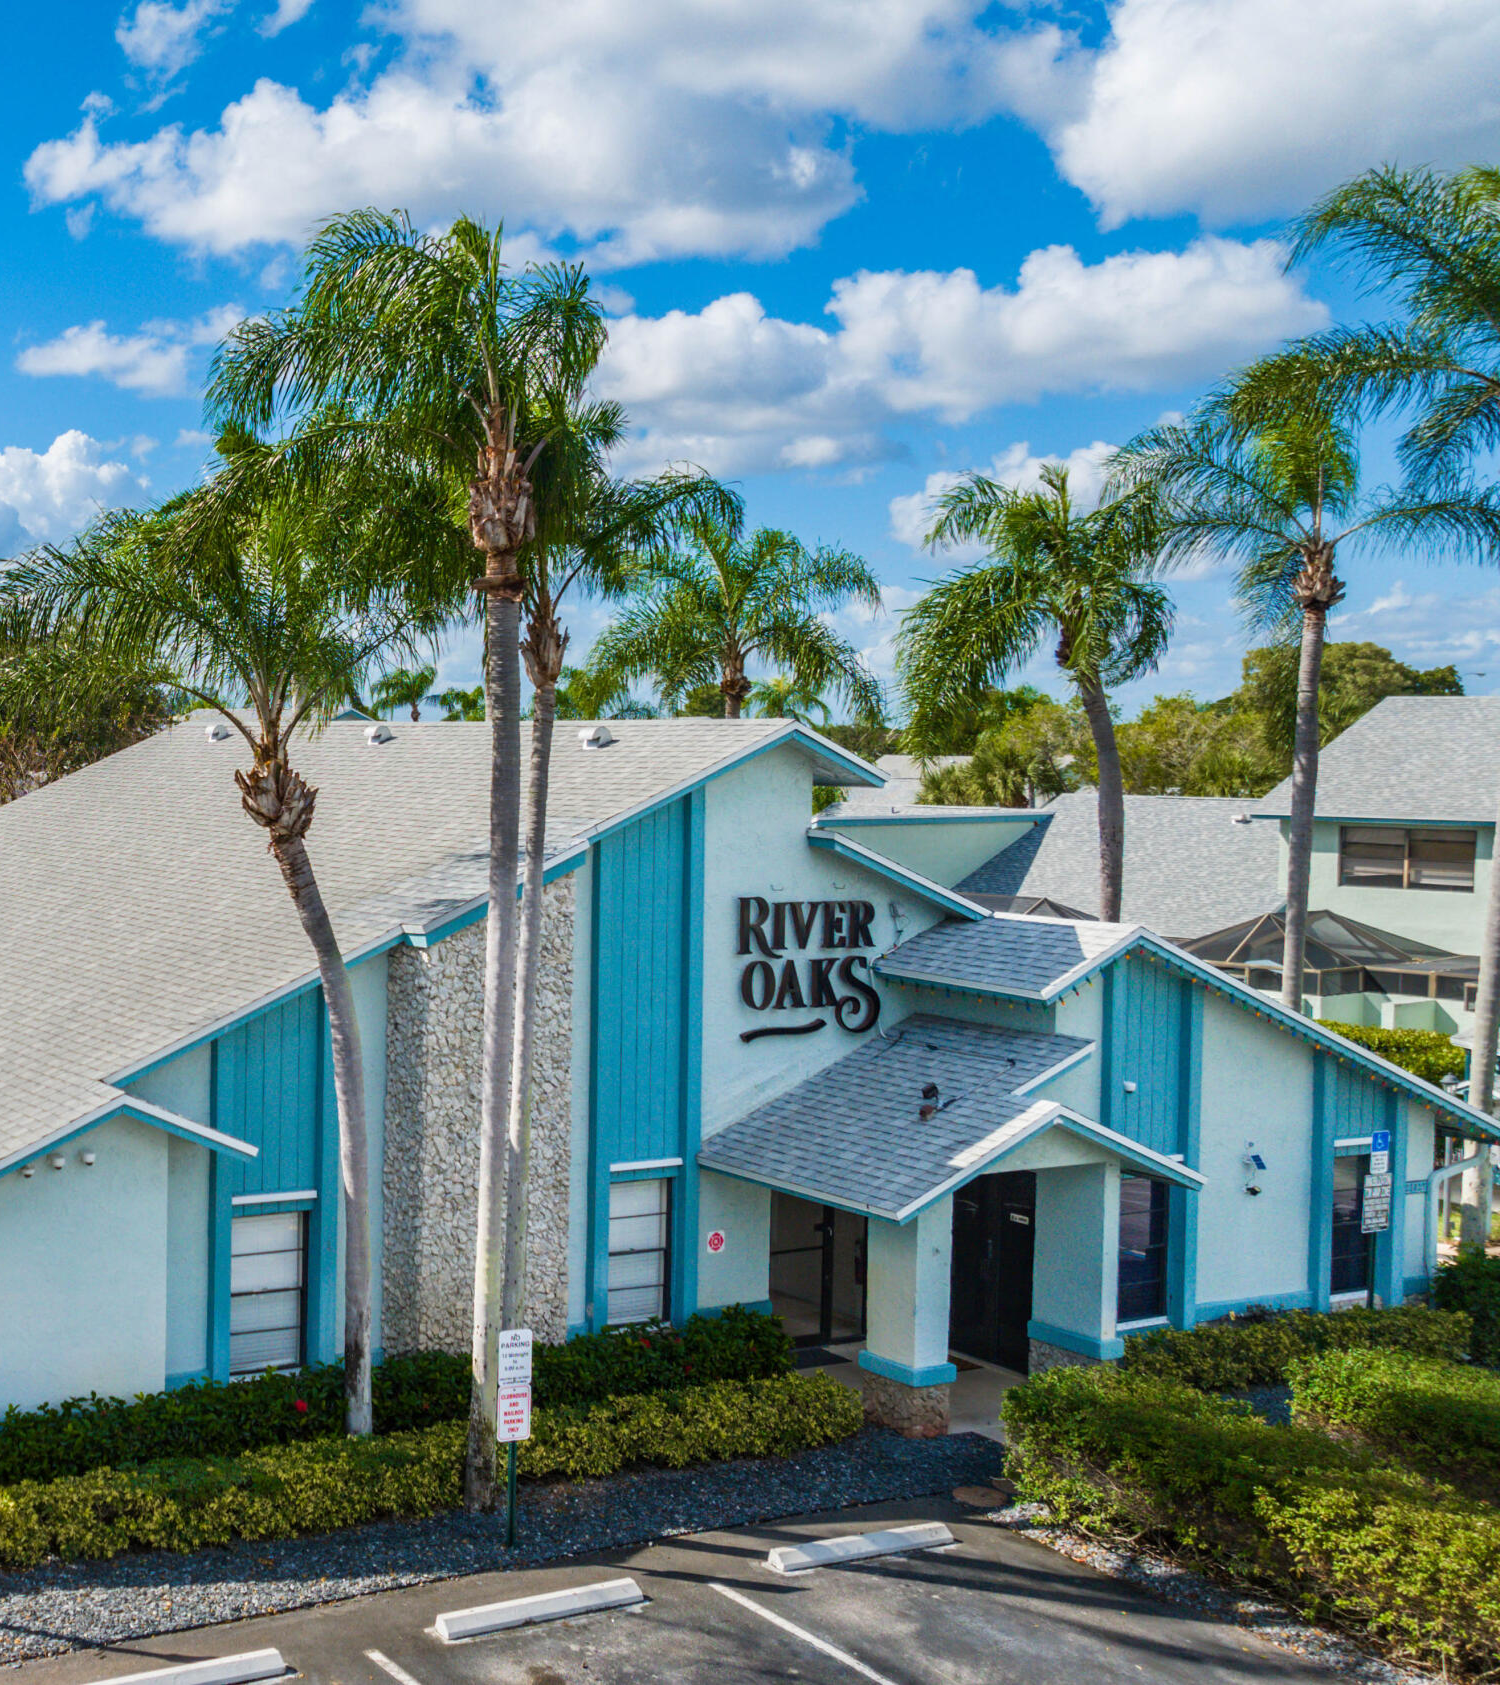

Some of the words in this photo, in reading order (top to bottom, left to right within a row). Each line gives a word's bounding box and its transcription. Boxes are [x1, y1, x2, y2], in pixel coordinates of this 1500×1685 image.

[736, 896, 877, 960] RIVER
[740, 955, 881, 1033] OAKS
[501, 1392, 527, 1400] CLUBHOUSE
